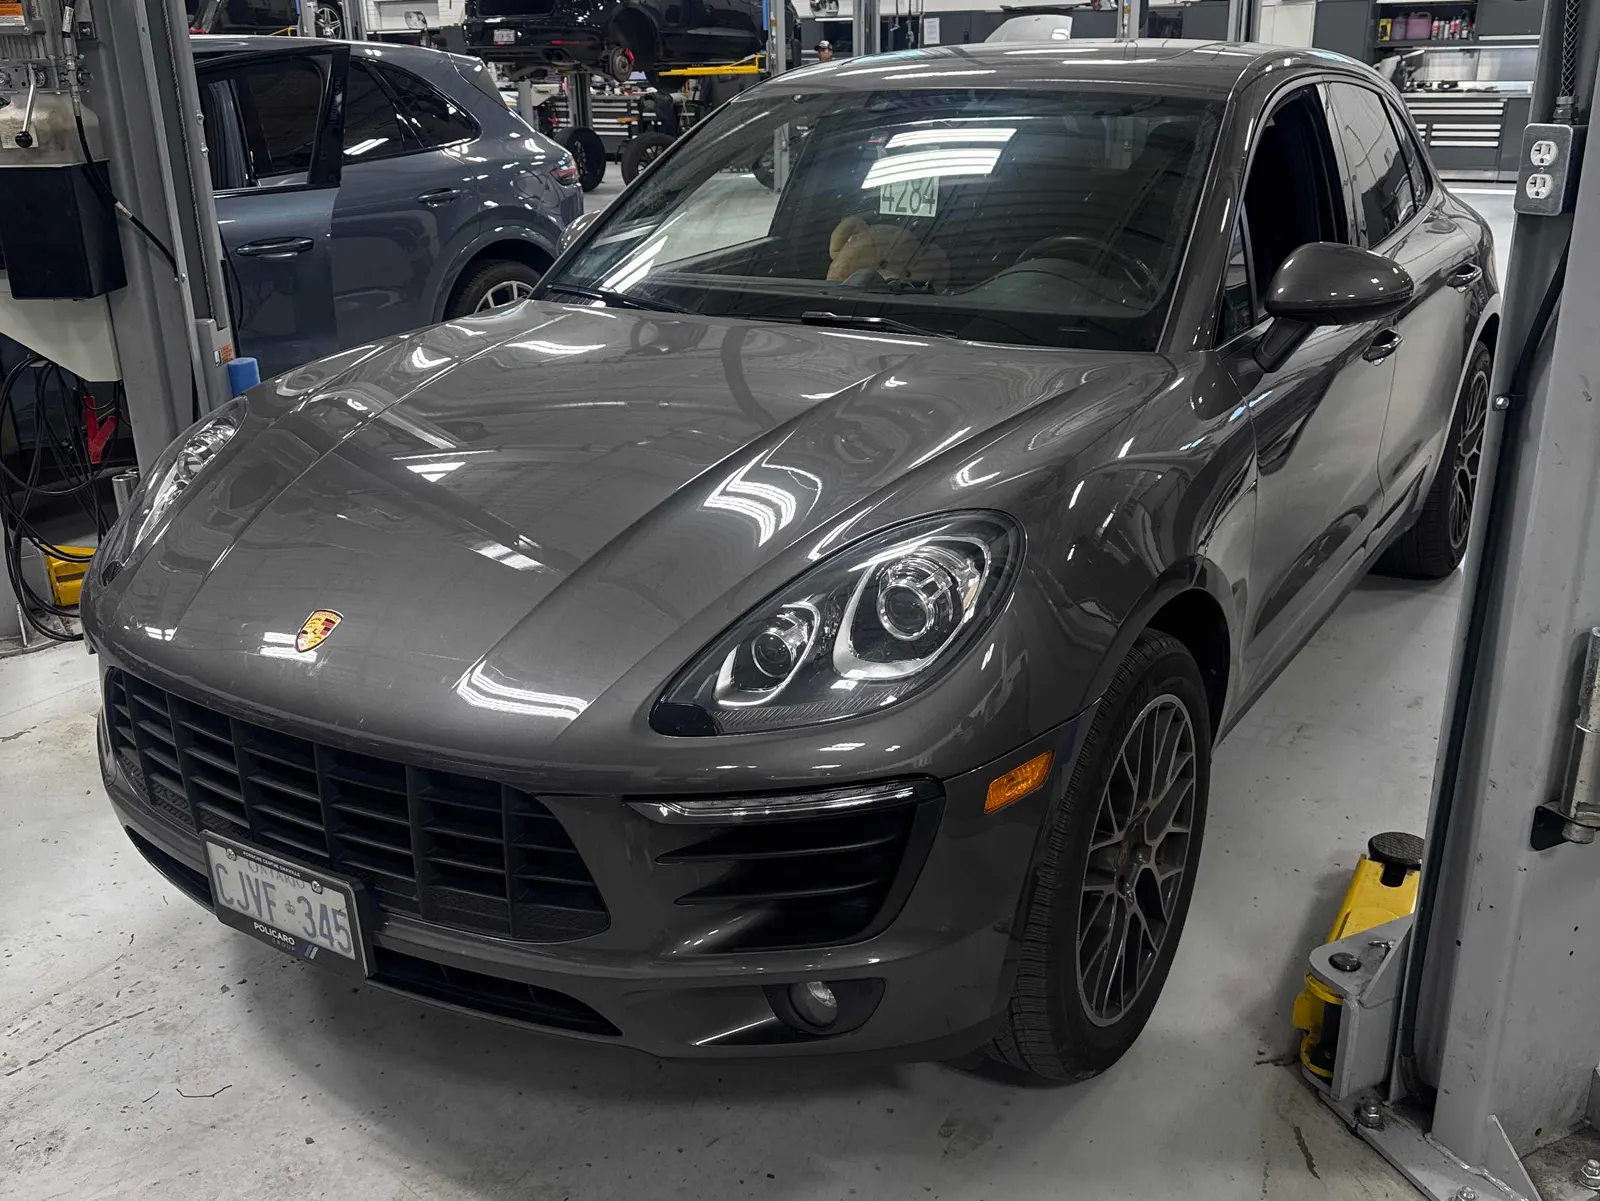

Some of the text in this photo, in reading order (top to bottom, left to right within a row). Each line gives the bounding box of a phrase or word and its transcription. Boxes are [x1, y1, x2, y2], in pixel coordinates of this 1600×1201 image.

[881, 176, 936, 214] 4284
[215, 863, 352, 953] CJVF 345
[253, 921, 295, 946] POLICARO
